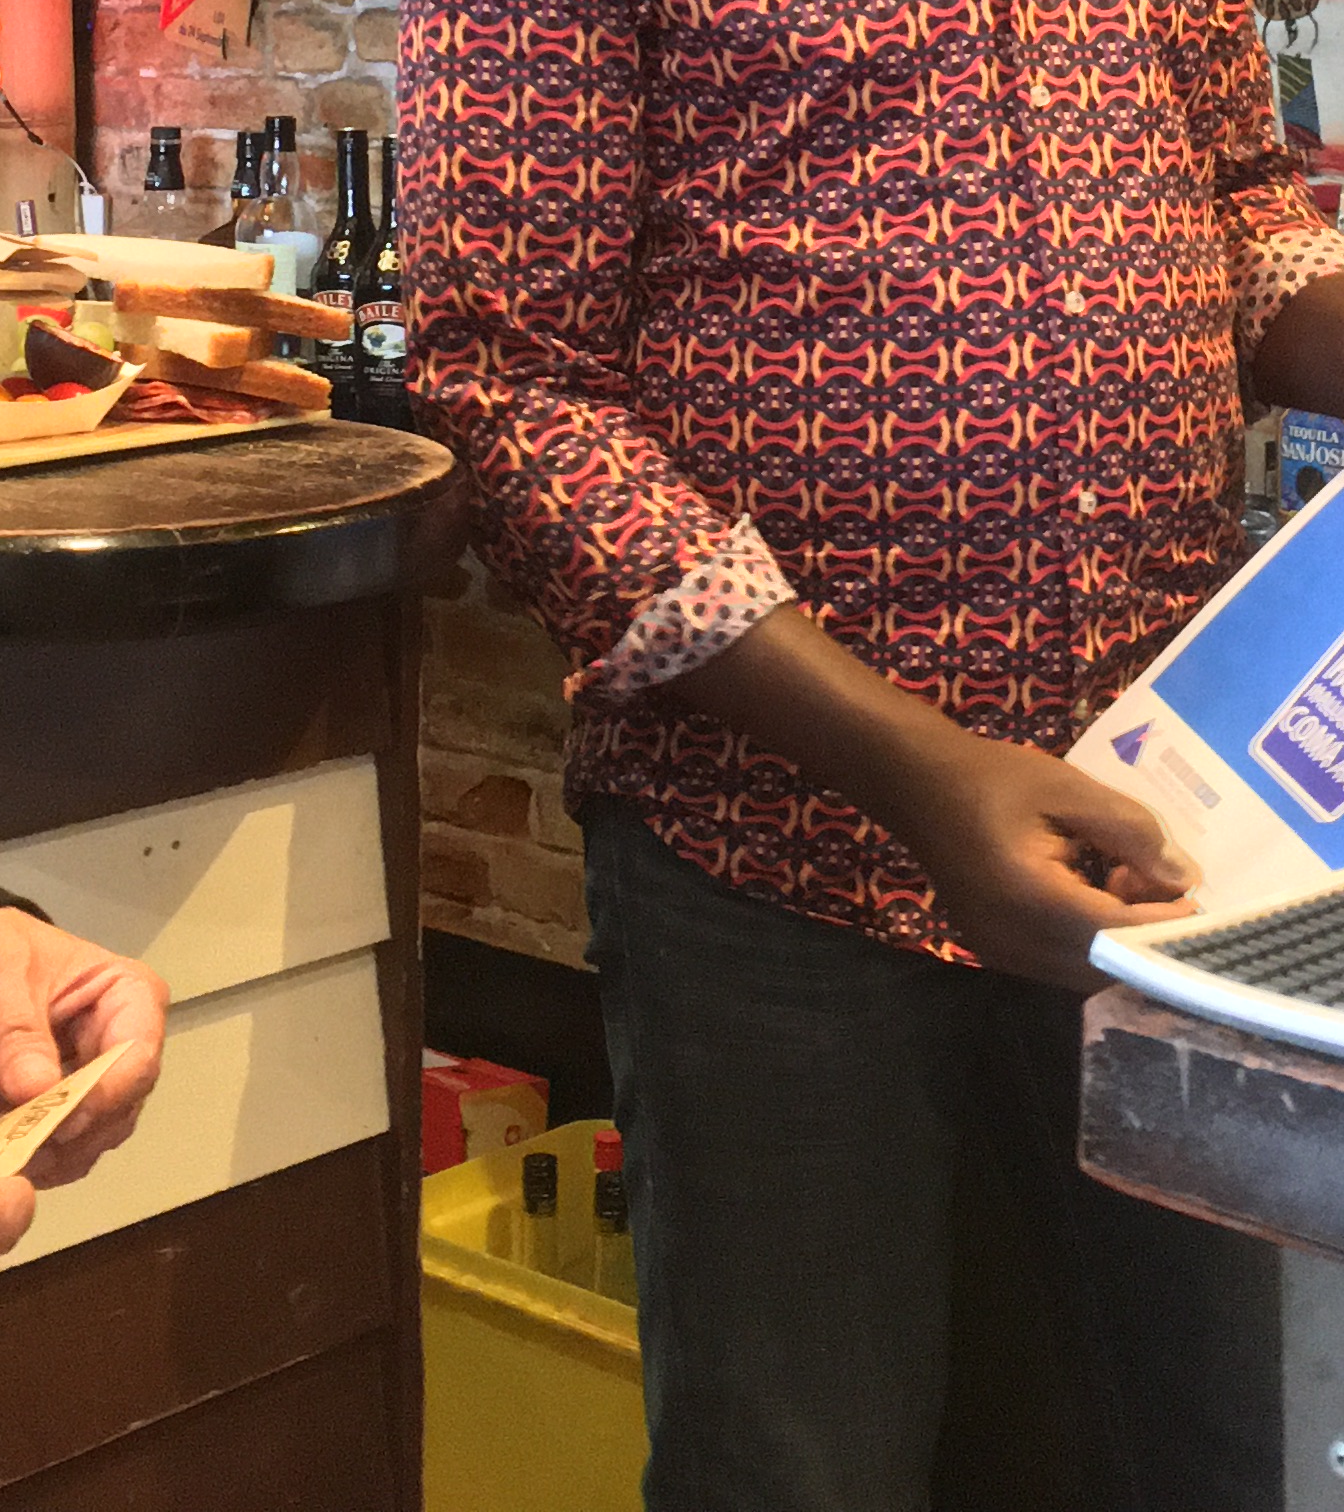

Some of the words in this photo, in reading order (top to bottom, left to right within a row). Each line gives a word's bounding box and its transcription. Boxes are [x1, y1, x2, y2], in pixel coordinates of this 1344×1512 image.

[358, 305, 400, 322] BAILE
[1288, 425, 1340, 444] TEQUILA
[1279, 705, 1344, 769] COMA
